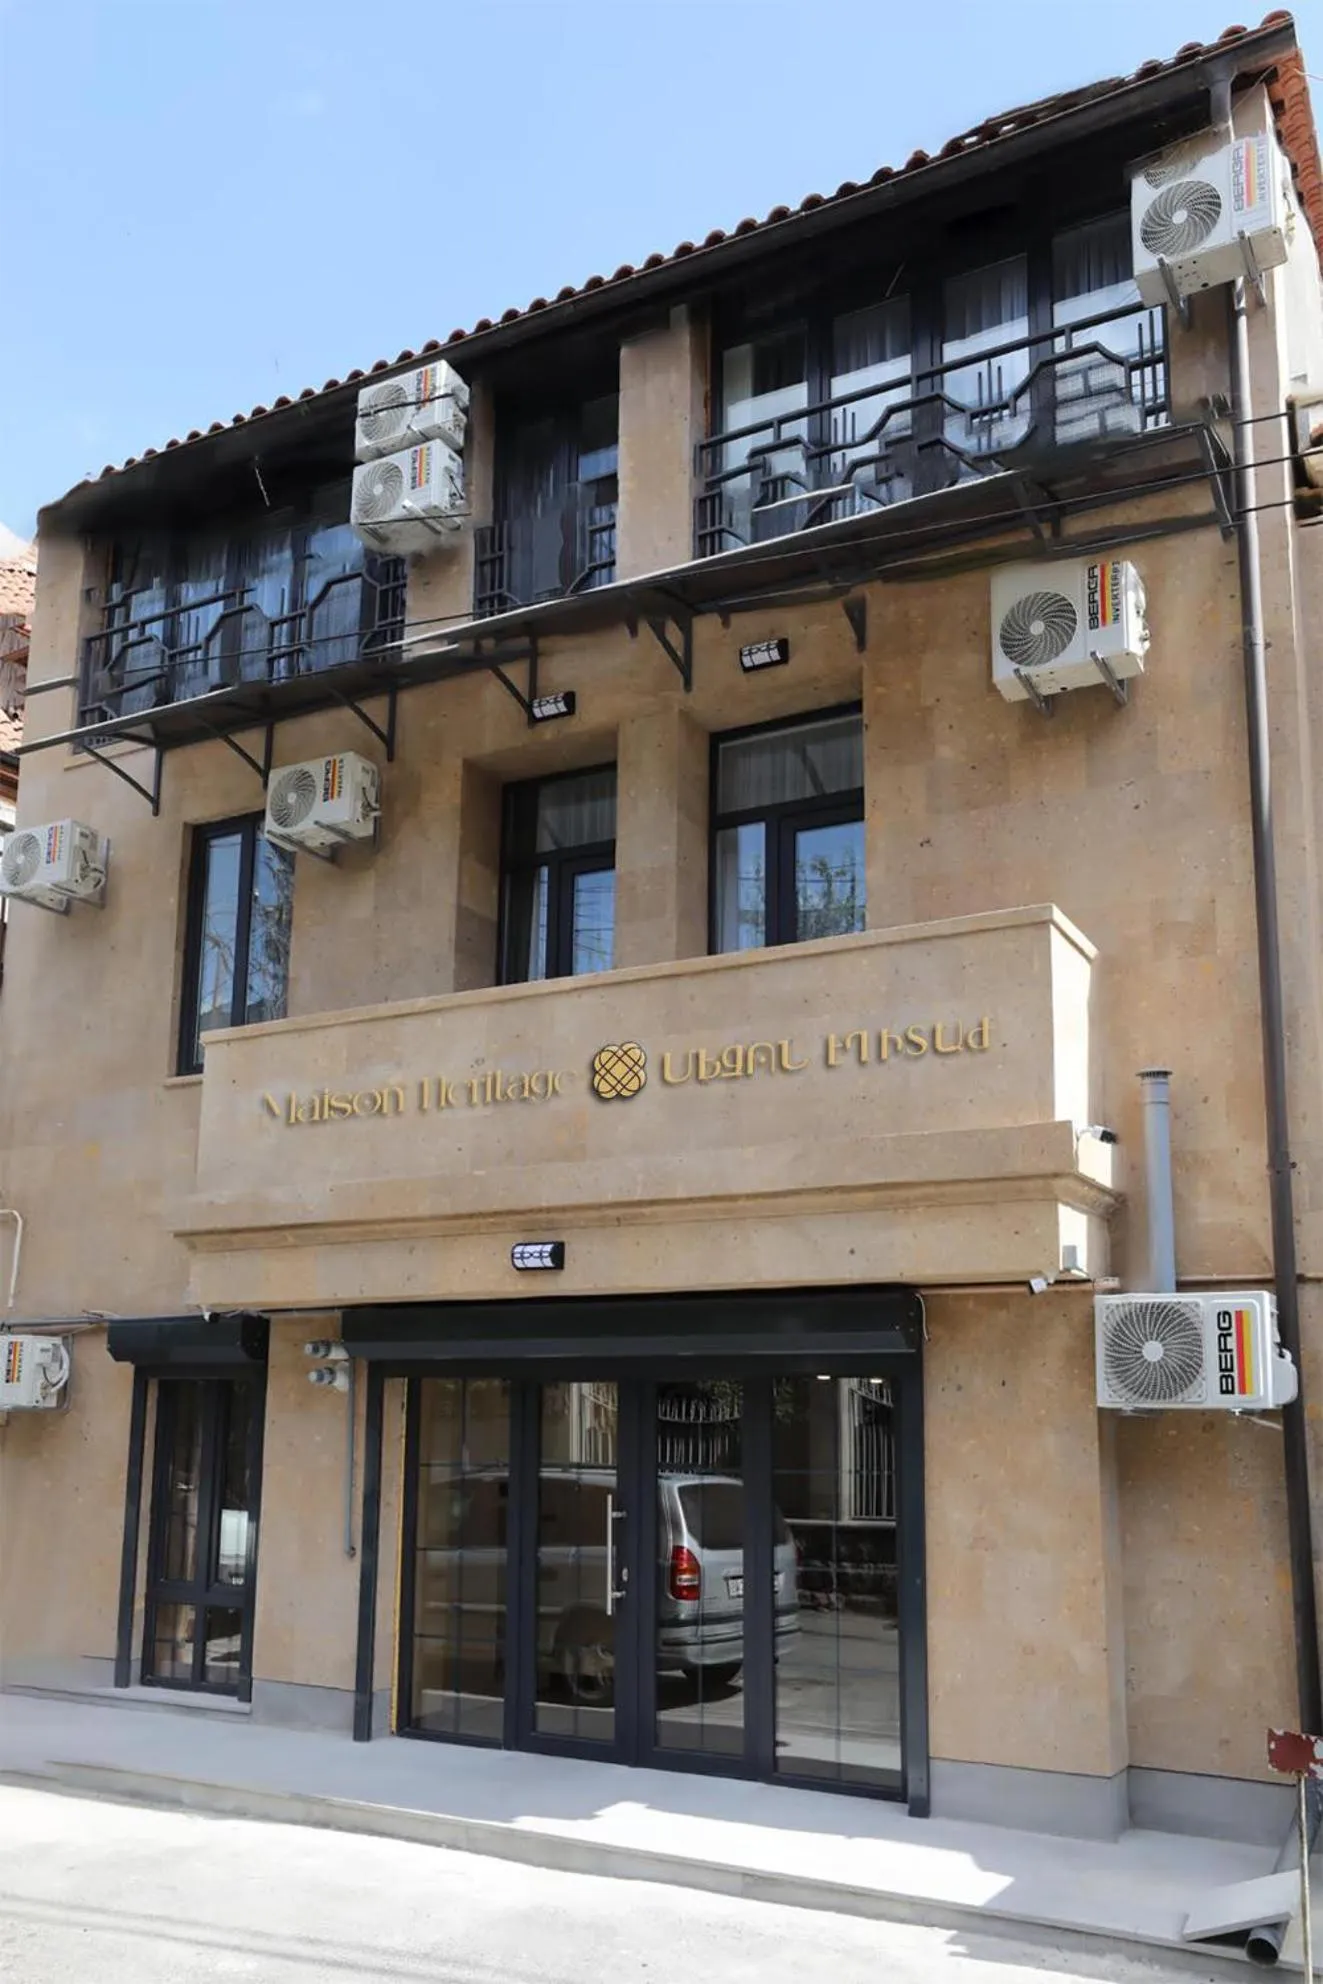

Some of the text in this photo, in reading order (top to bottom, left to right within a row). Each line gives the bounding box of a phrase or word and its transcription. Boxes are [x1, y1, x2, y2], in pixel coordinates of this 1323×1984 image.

[262, 1069, 578, 1124] Maison Heritage
[1216, 1310, 1236, 1395] BERG
